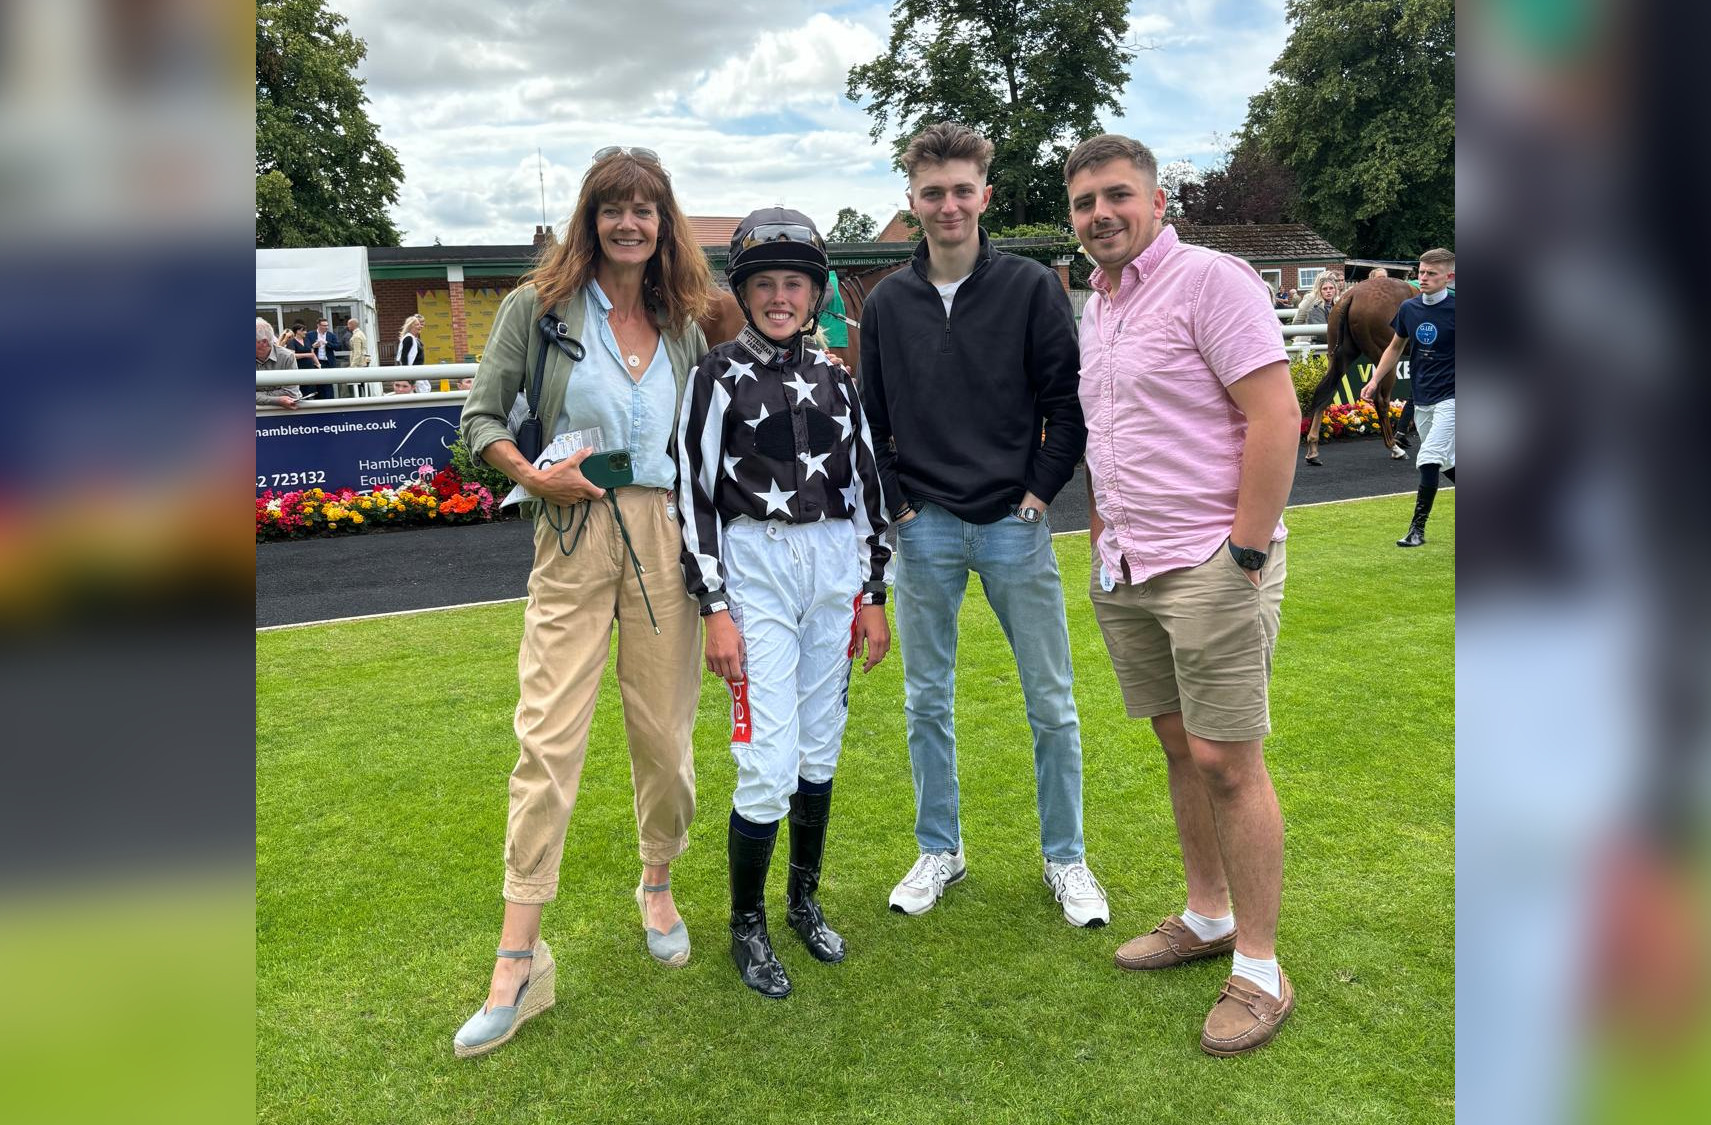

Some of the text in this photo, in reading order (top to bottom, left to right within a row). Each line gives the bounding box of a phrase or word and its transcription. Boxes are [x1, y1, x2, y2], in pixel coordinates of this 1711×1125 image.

[359, 456, 433, 470] Hambleton
[256, 470, 326, 488] 2 723132
[360, 472, 406, 487] Equine
